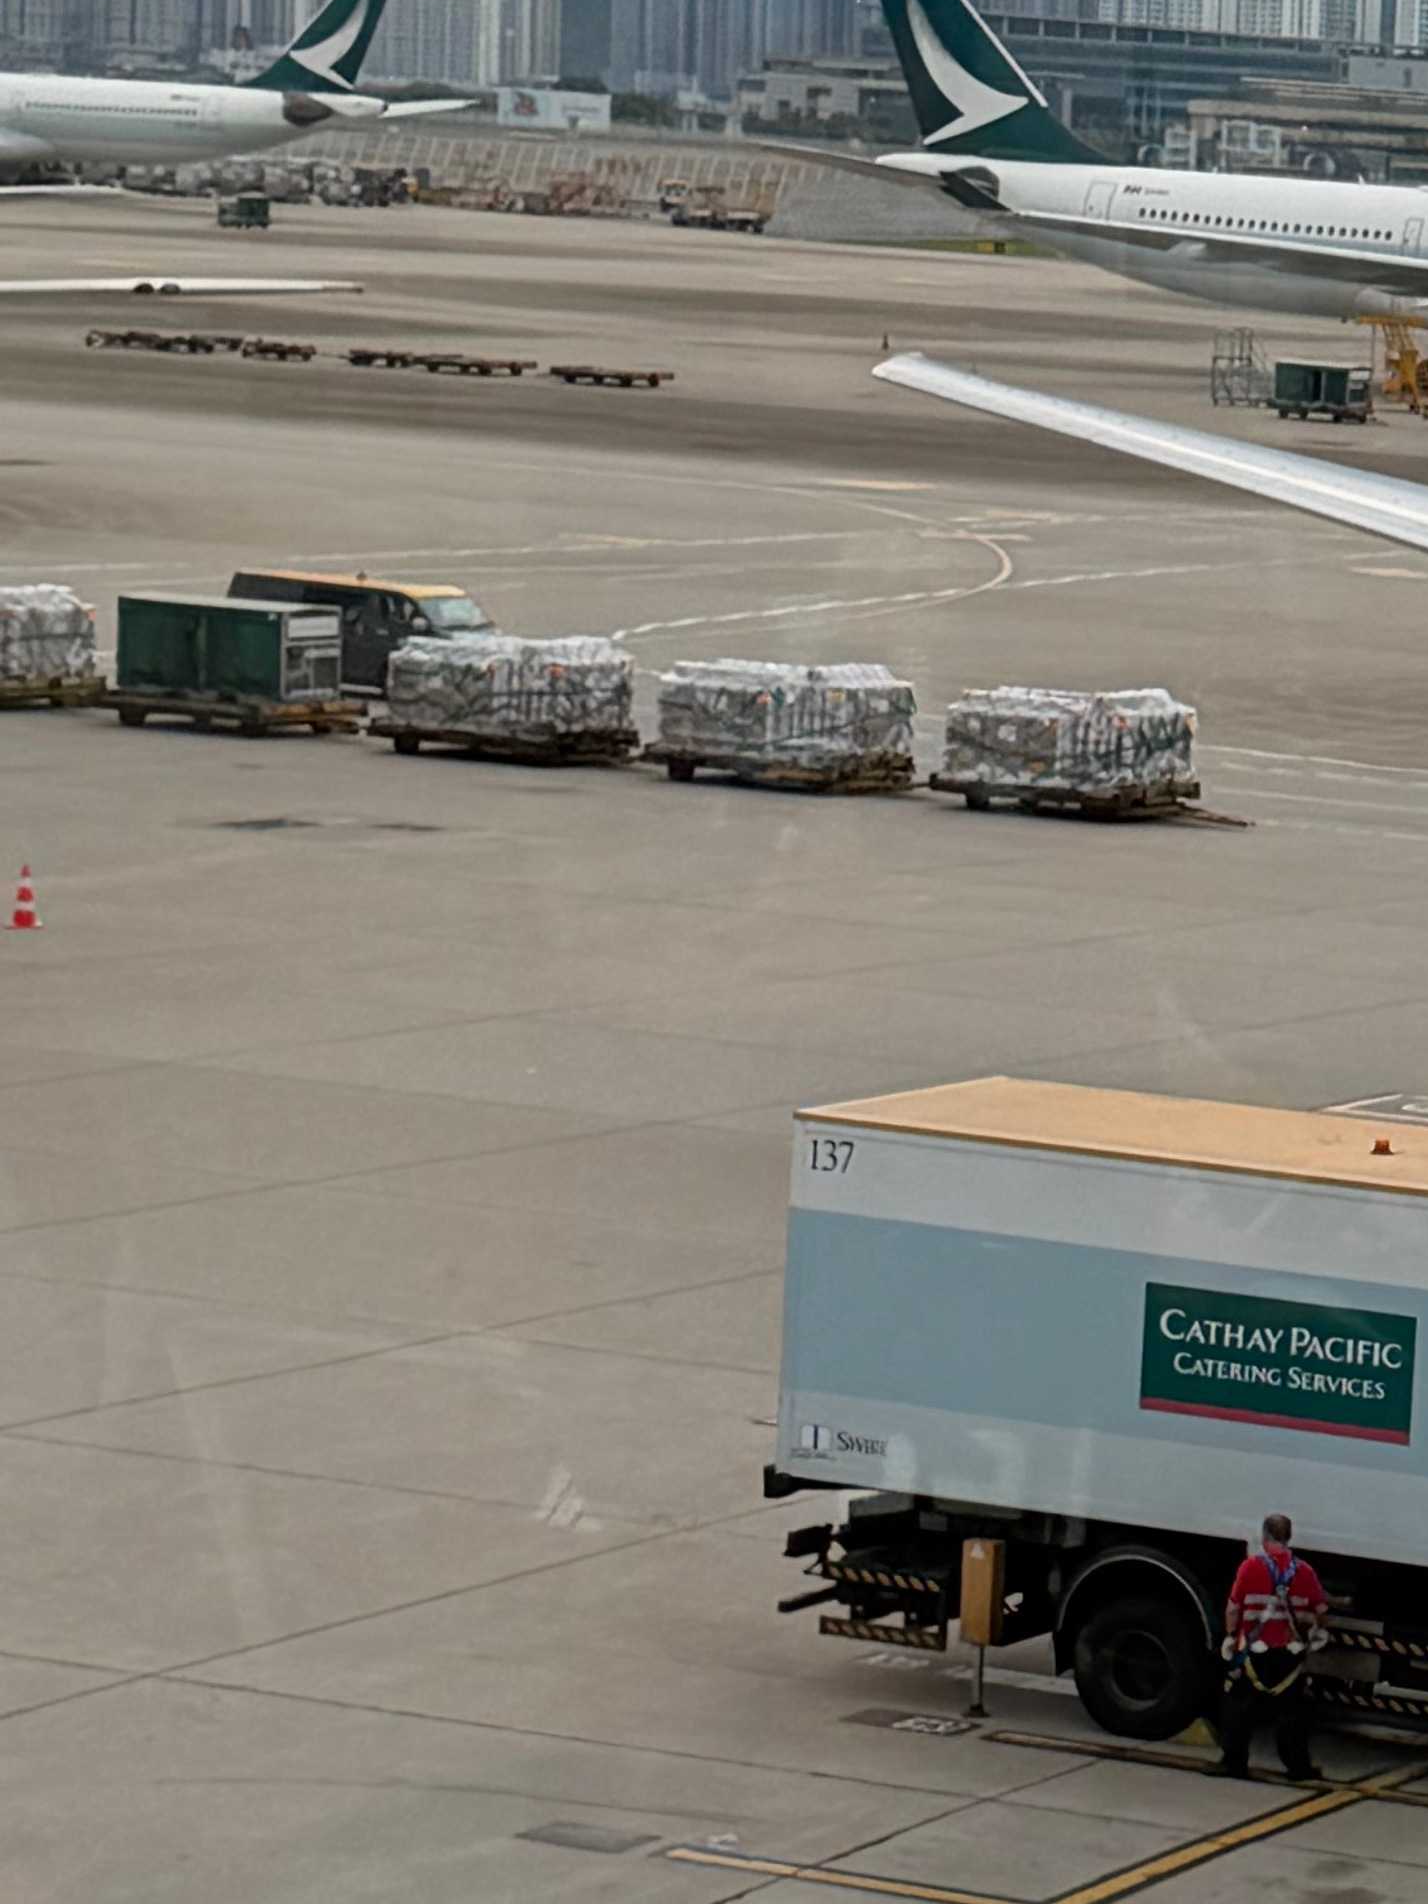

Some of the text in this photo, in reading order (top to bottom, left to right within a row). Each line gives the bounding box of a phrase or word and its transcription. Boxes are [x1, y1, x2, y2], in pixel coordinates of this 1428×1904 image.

[811, 1139, 855, 1174] 137
[1159, 1307, 1403, 1369] CATHAY PACIFIC
[1173, 1351, 1386, 1399] CATERING SERVICES
